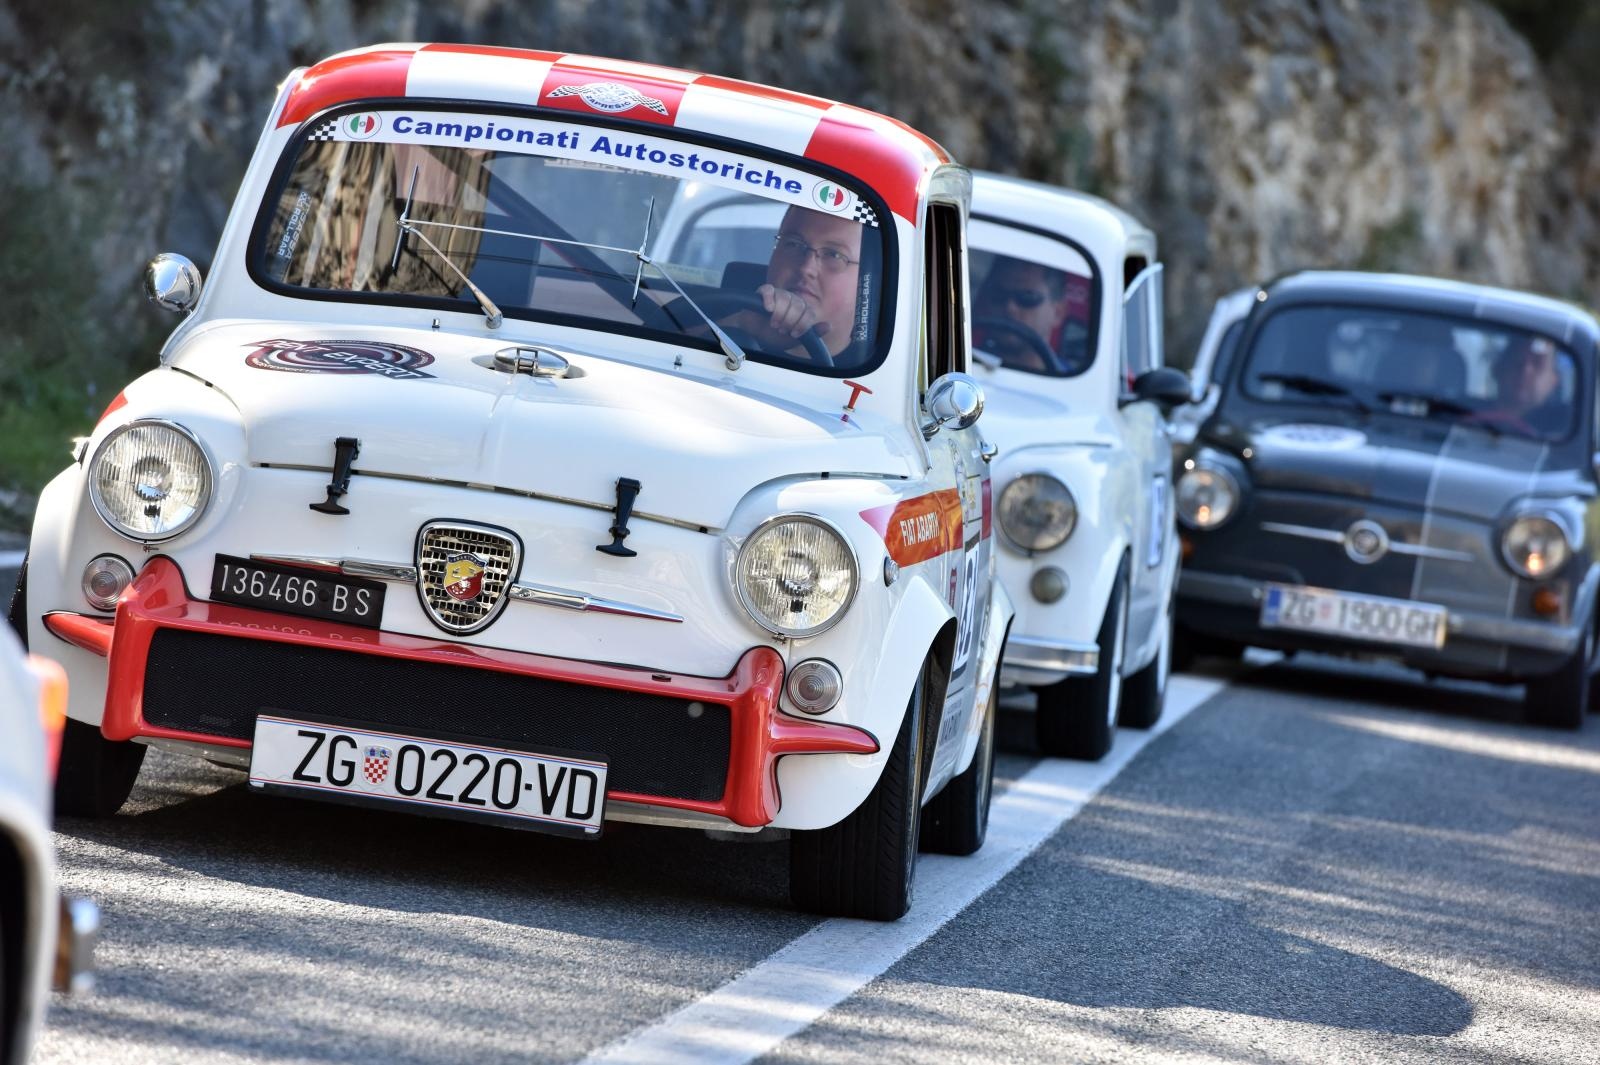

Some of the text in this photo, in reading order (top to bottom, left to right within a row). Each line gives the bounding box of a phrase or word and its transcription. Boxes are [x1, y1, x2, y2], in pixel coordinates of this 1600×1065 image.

[392, 116, 580, 149] Campionati
[590, 136, 803, 194] Autostoriche
[277, 207, 302, 257] ROLL-BAR
[861, 273, 872, 324] ROLL-BAR
[323, 351, 423, 378] EXPERT
[900, 511, 940, 547] FIAT ABARTH
[221, 564, 371, 616] 136466 BS
[292, 729, 358, 787] ZG
